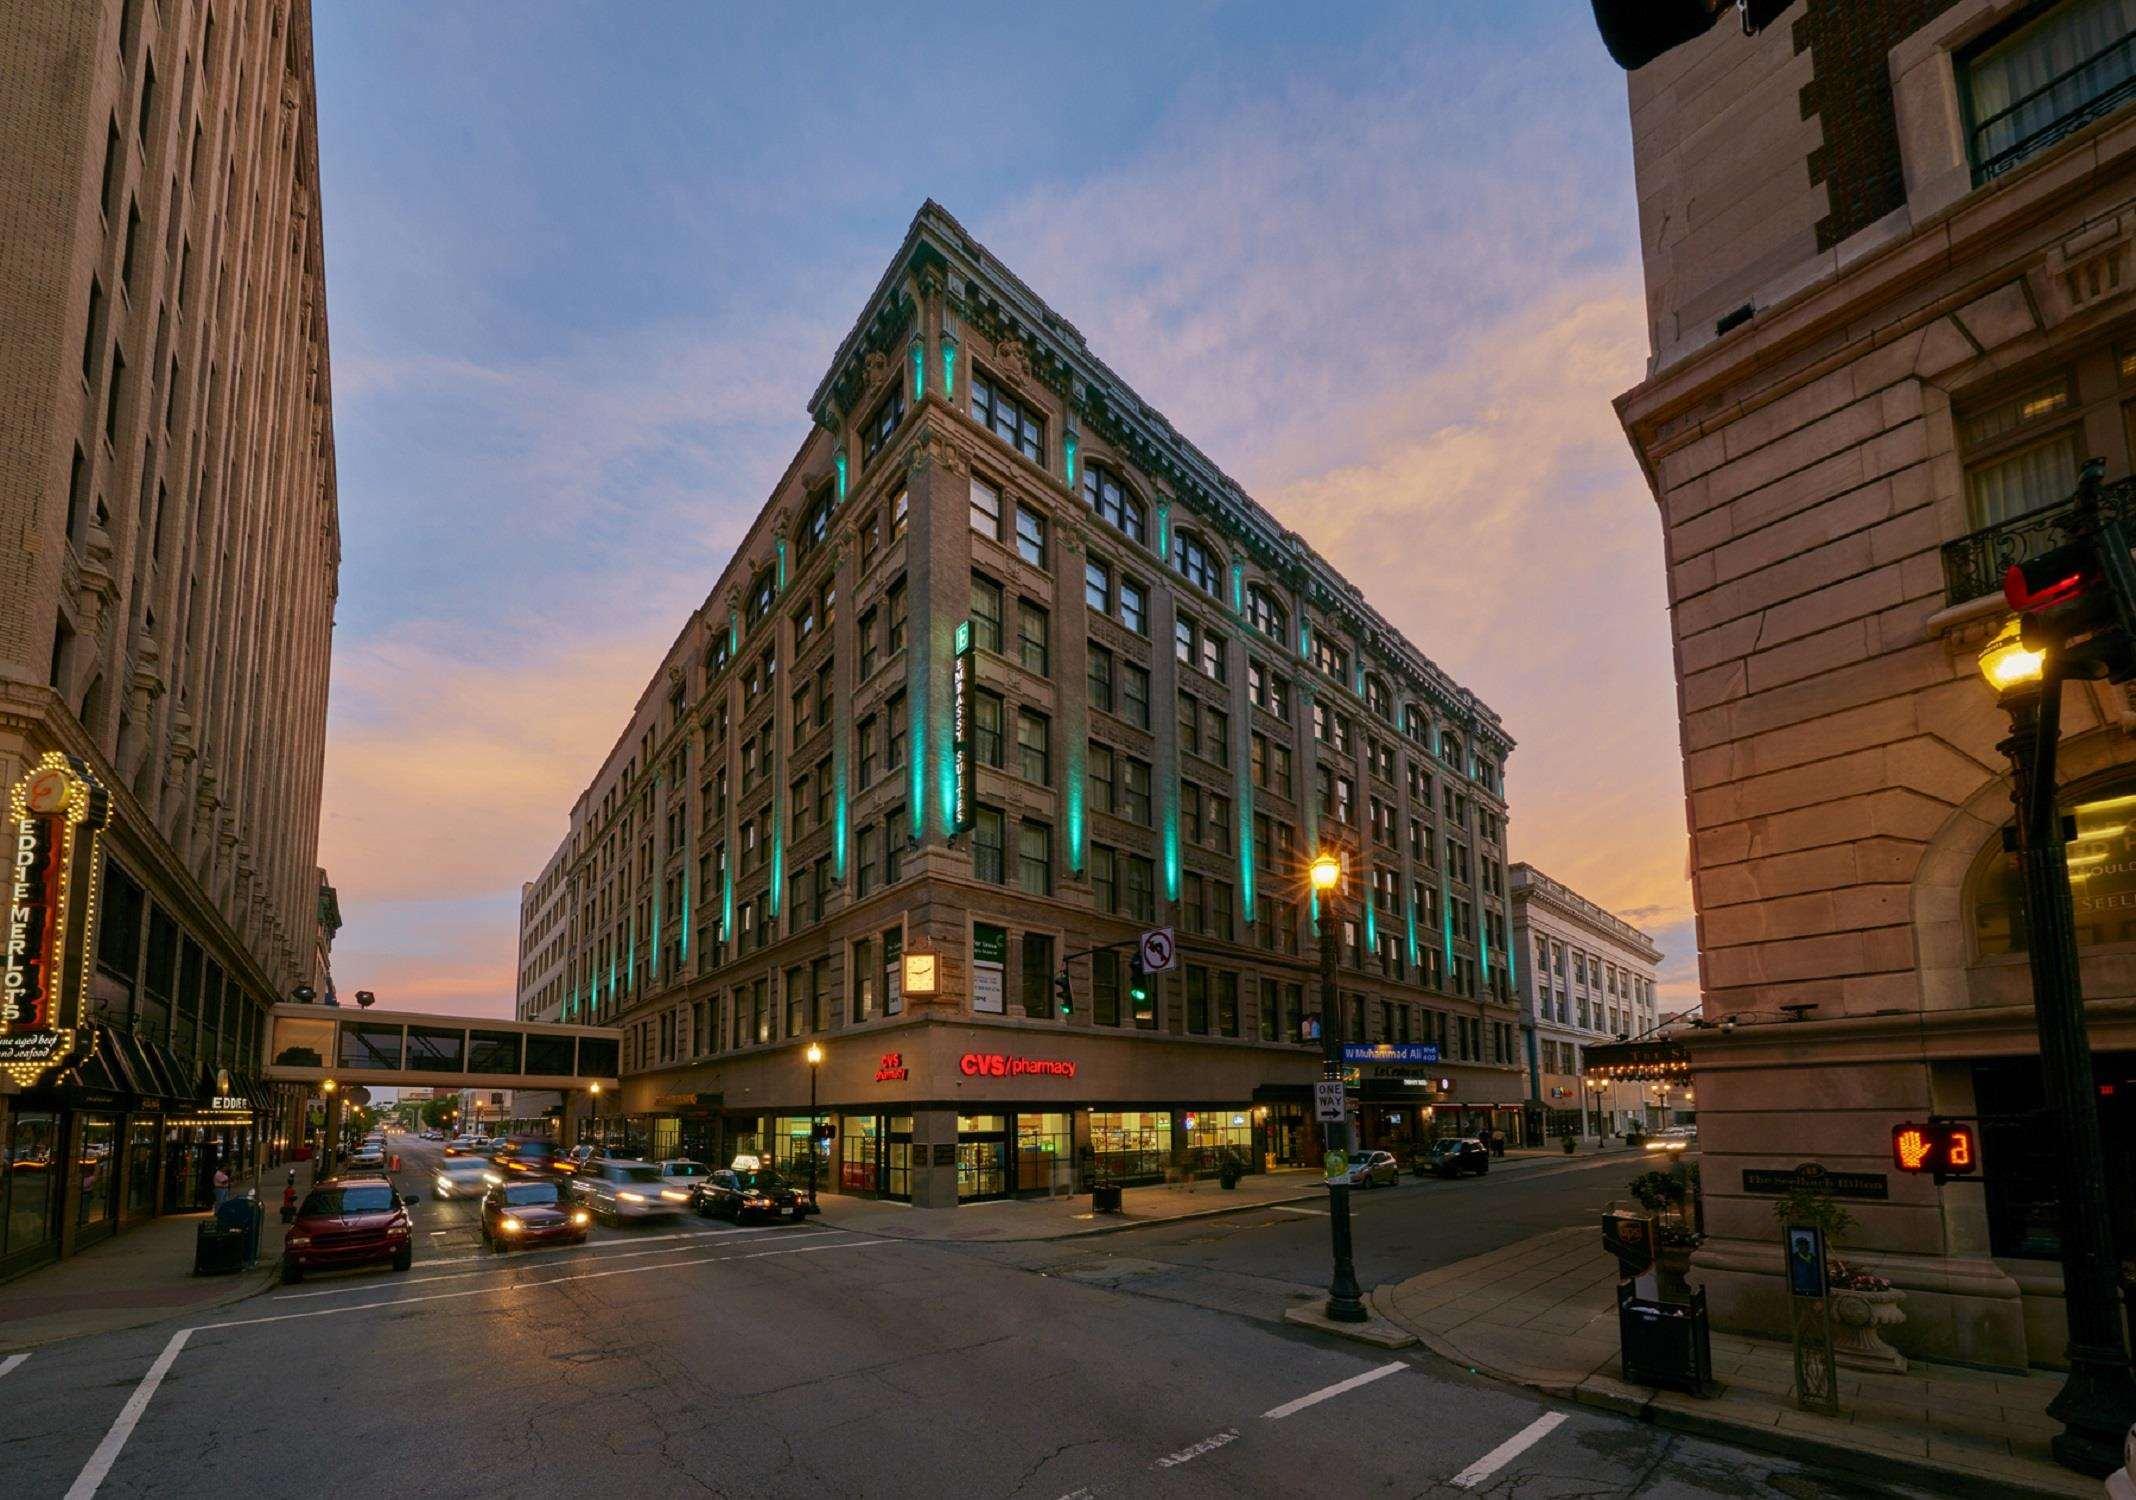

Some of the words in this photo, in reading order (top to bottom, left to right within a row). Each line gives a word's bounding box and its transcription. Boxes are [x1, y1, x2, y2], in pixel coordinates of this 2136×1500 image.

[955, 750, 964, 822] SUITES
[14, 819, 37, 898] EDDIE
[4, 906, 30, 1020] MERLOT'S
[14, 1034, 38, 1048] aged
[38, 1034, 58, 1048] beef
[14, 1047, 50, 1060] seafood
[880, 1053, 902, 1067] CVS
[1345, 1048, 1354, 1058] W
[1355, 1048, 1407, 1059] Muhammad
[1409, 1048, 1421, 1059] Ali
[1319, 1085, 1341, 1094] ONE
[1319, 1097, 1342, 1106] WAY
